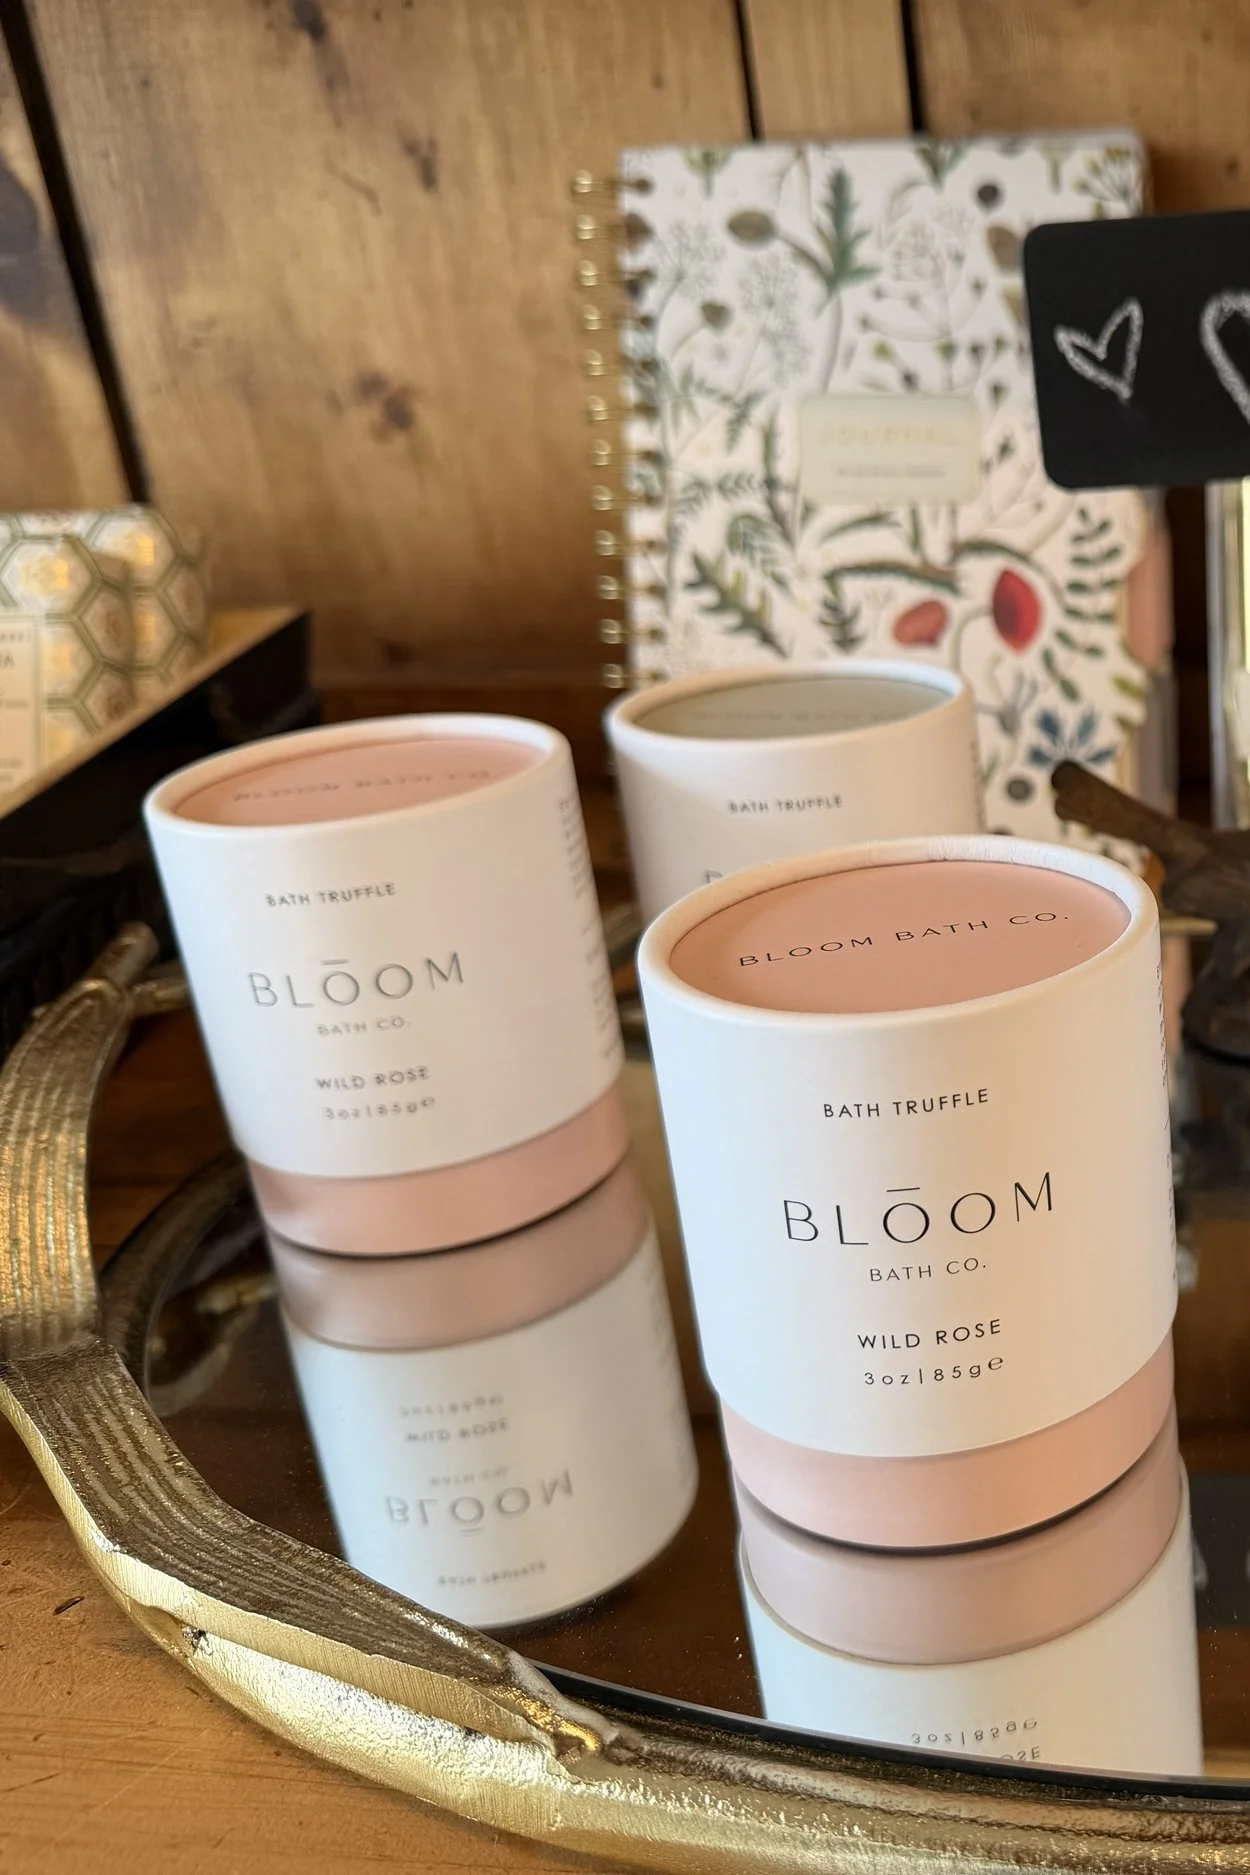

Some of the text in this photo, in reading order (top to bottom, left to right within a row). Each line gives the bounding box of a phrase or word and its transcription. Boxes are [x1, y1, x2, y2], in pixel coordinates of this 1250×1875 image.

[728, 793, 844, 815] BATH TRUFFLE
[266, 882, 399, 908] BATH TRUFFLE
[739, 911, 1070, 967] BLOOM BATH CO.
[316, 1014, 412, 1037] BATH CO.
[316, 1066, 431, 1091] WILD ROSE
[823, 1088, 990, 1119] BATH TRUFFLE
[869, 1256, 988, 1283] BATH CO.
[857, 1318, 1003, 1351] WILD ROSE
